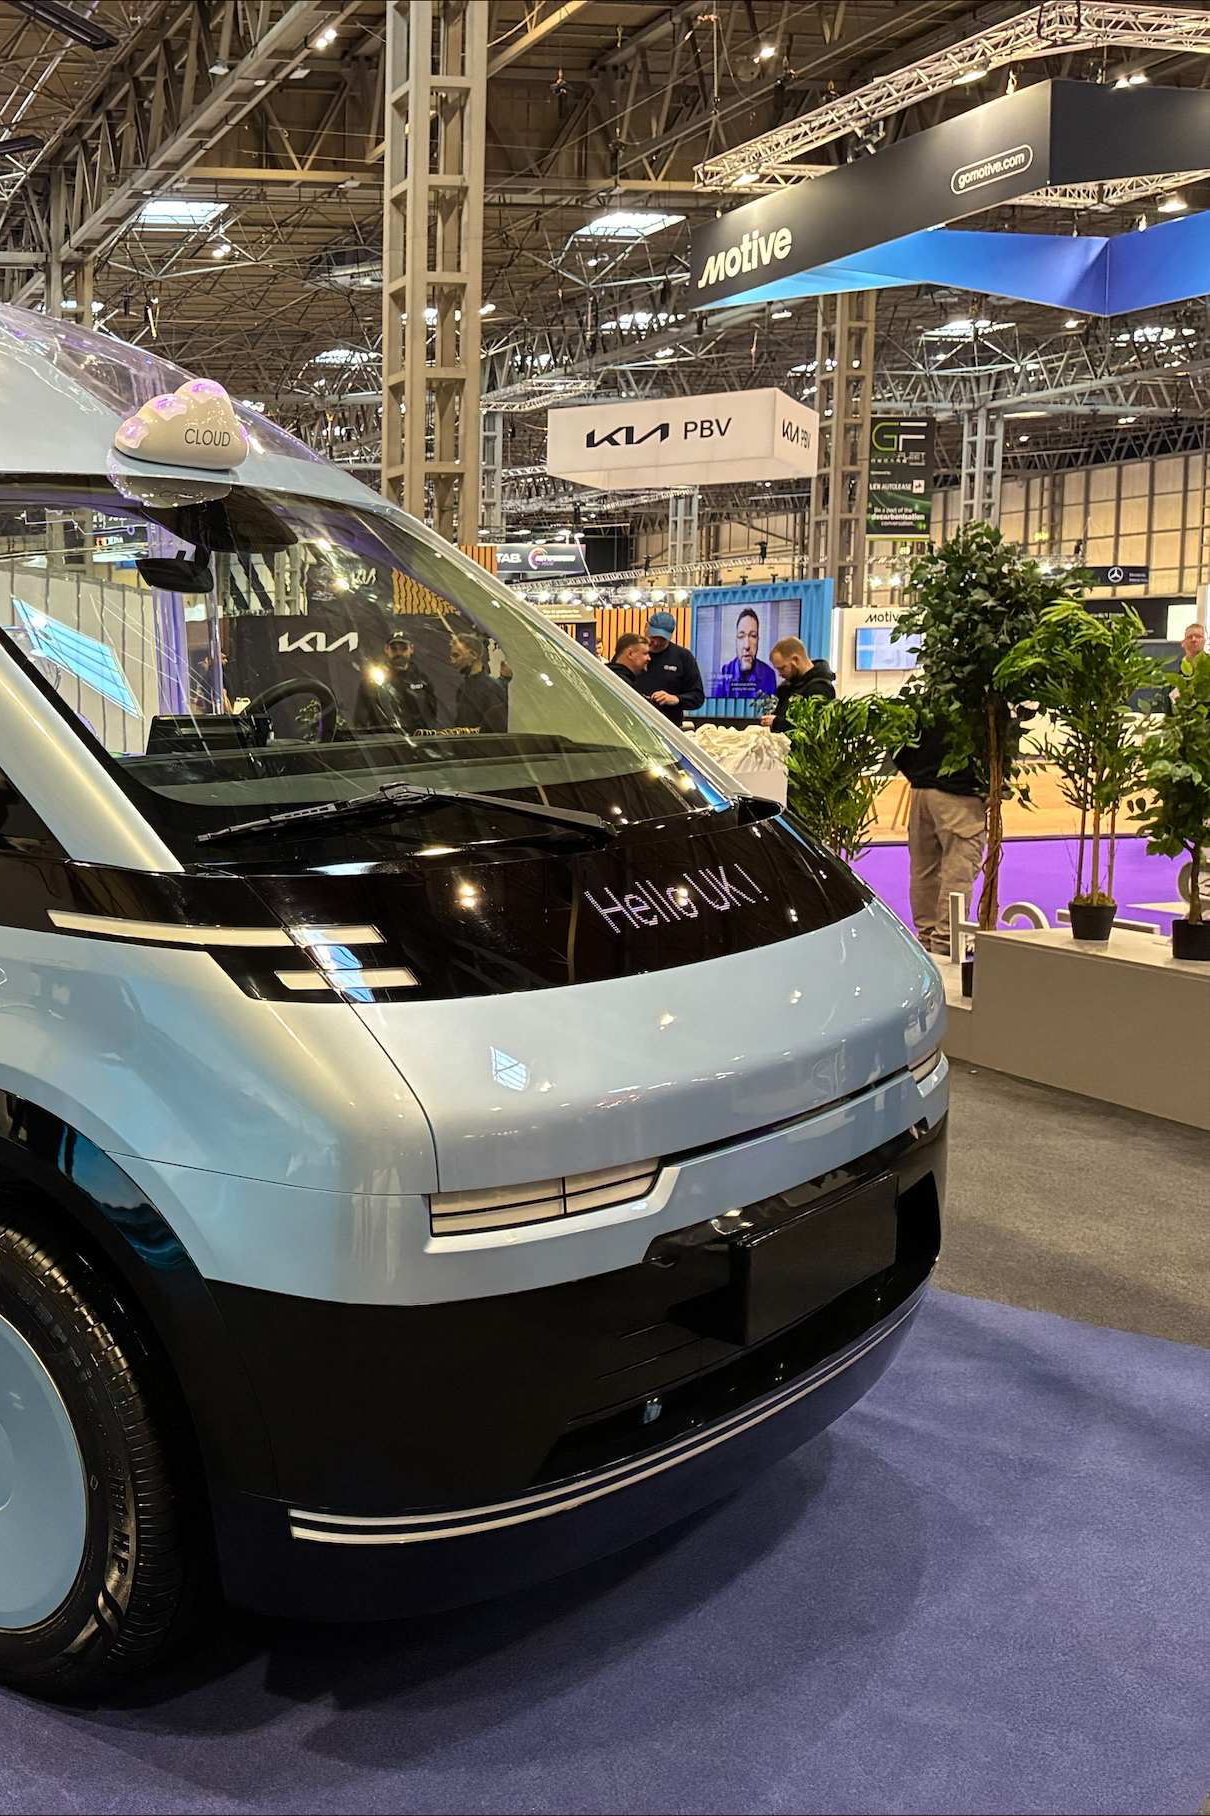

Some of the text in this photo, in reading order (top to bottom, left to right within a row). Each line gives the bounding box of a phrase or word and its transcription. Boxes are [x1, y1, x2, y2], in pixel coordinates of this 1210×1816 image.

[957, 152, 1026, 188] gomotive.com
[698, 227, 793, 289] Motive
[184, 428, 231, 447] CLOUD
[586, 417, 732, 448] KIA PBV
[800, 429, 812, 450] PBV
[871, 513, 925, 521] decarbonisation
[865, 611, 899, 623] Motiv
[278, 631, 359, 653] KIA
[584, 880, 699, 933] Hello
